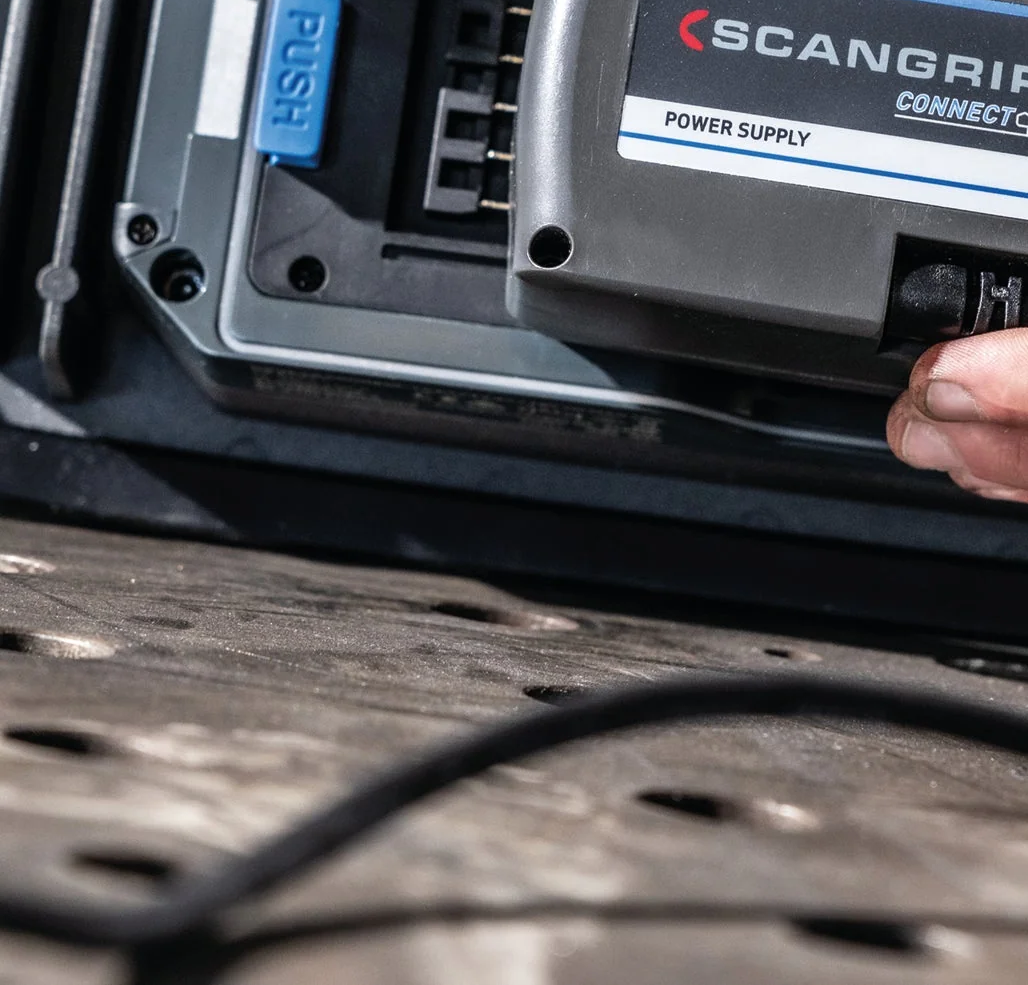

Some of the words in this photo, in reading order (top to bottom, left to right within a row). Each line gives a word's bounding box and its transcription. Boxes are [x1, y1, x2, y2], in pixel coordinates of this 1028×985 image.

[271, 8, 325, 131] PUSH
[895, 90, 1018, 127] CONNECT
[664, 110, 733, 136] POWER
[737, 121, 812, 148] SUPPLY
